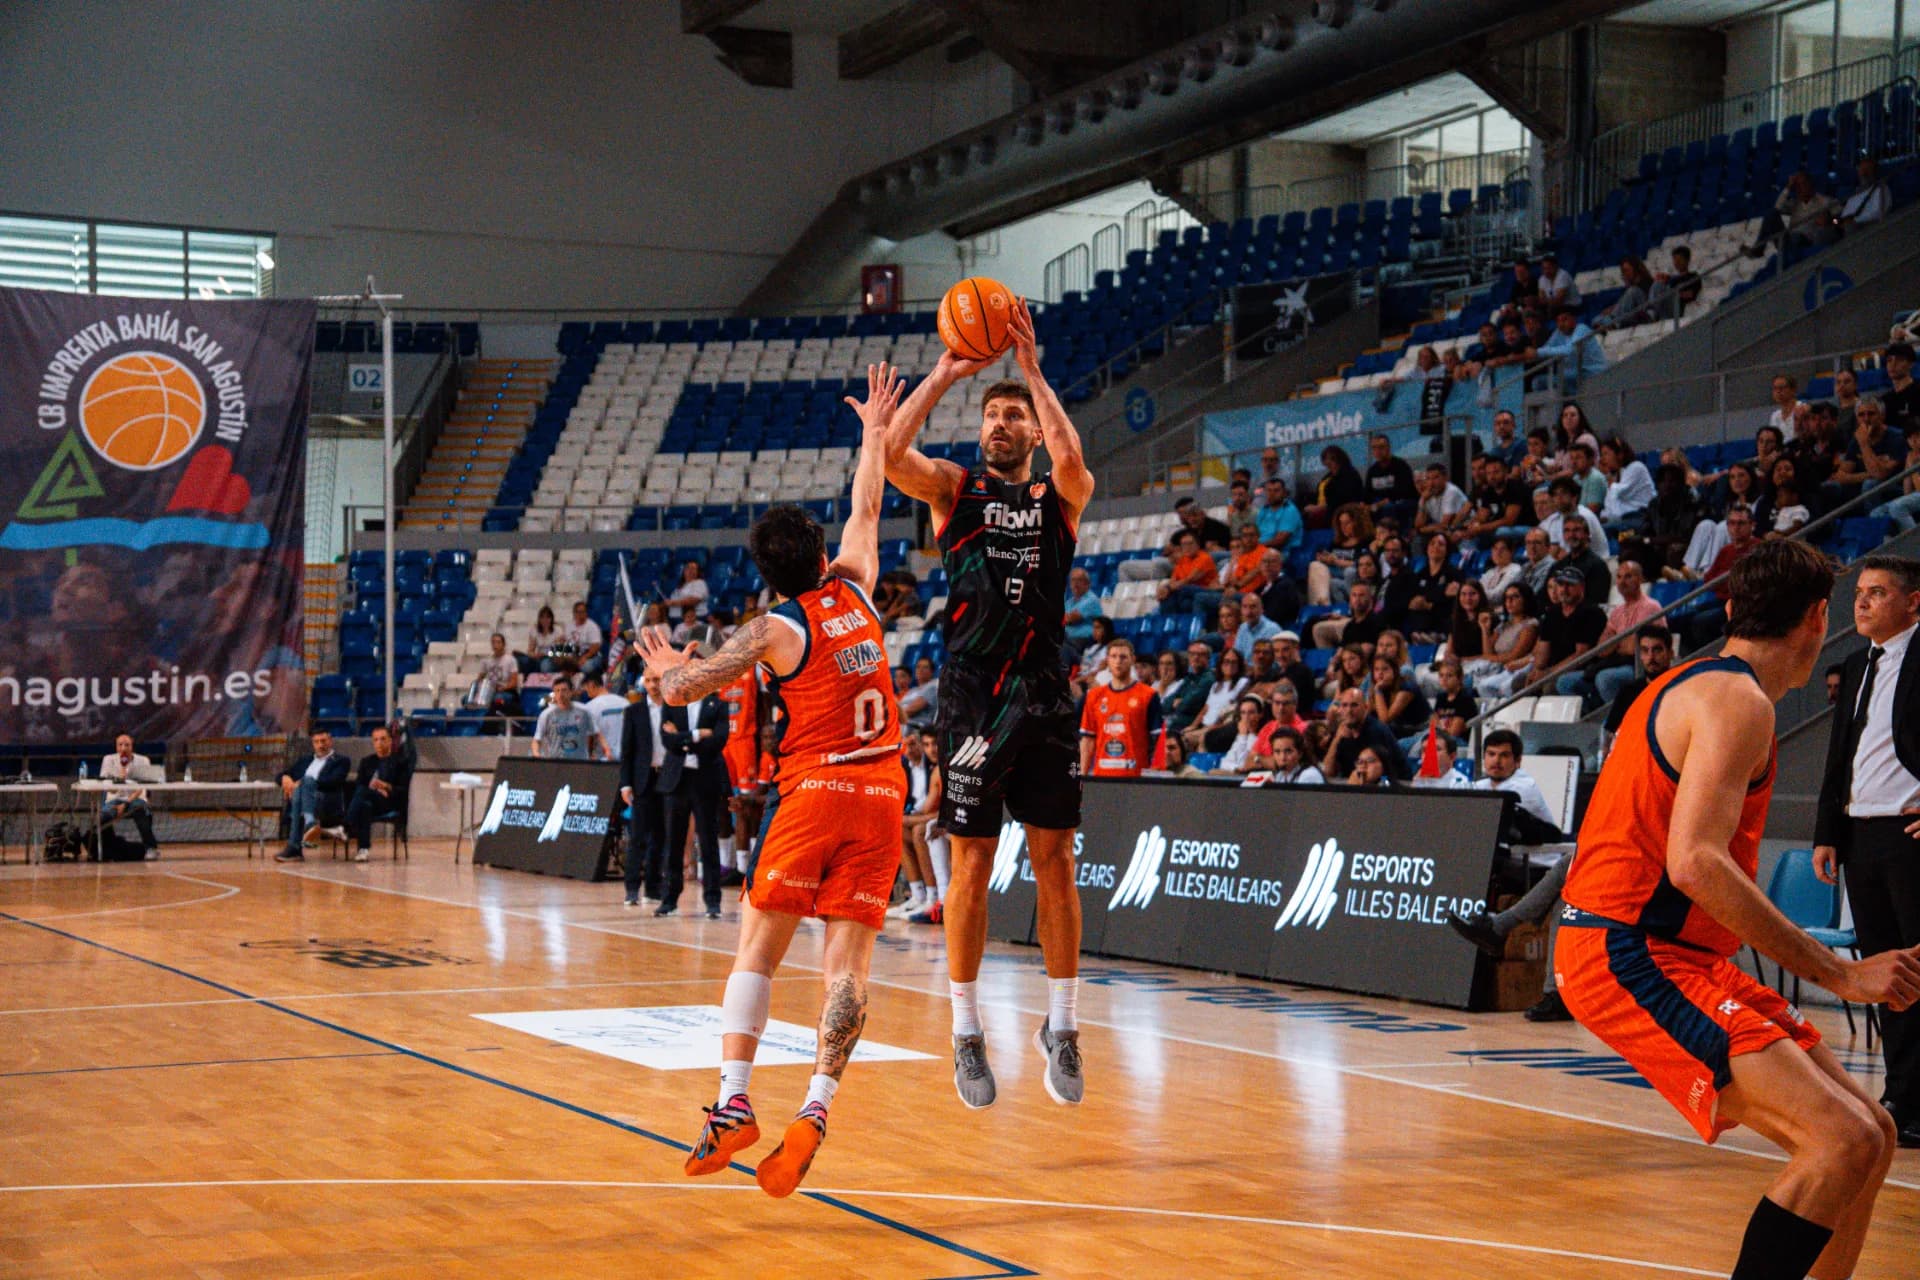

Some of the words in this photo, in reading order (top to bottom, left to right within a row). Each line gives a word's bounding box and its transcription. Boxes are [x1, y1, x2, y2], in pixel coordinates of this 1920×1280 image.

[116, 310, 180, 345] BAHÍA
[39, 320, 119, 401] IMPRENTA
[178, 325, 224, 366] SAN
[352, 368, 381, 388] 02
[37, 403, 67, 430] CB
[207, 360, 249, 442] AGUSTÍN
[983, 502, 1042, 530] fibwi
[1004, 577, 1024, 605] 13
[821, 608, 869, 638] CUEVAS
[854, 688, 886, 742] 0
[1169, 839, 1240, 869] ESPORTS
[1074, 863, 1116, 889] LEARS
[1350, 853, 1435, 887] ESPORTS
[1164, 871, 1209, 900] ILLES
[1206, 874, 1282, 907] BALEARS
[1344, 888, 1395, 919] ILLES
